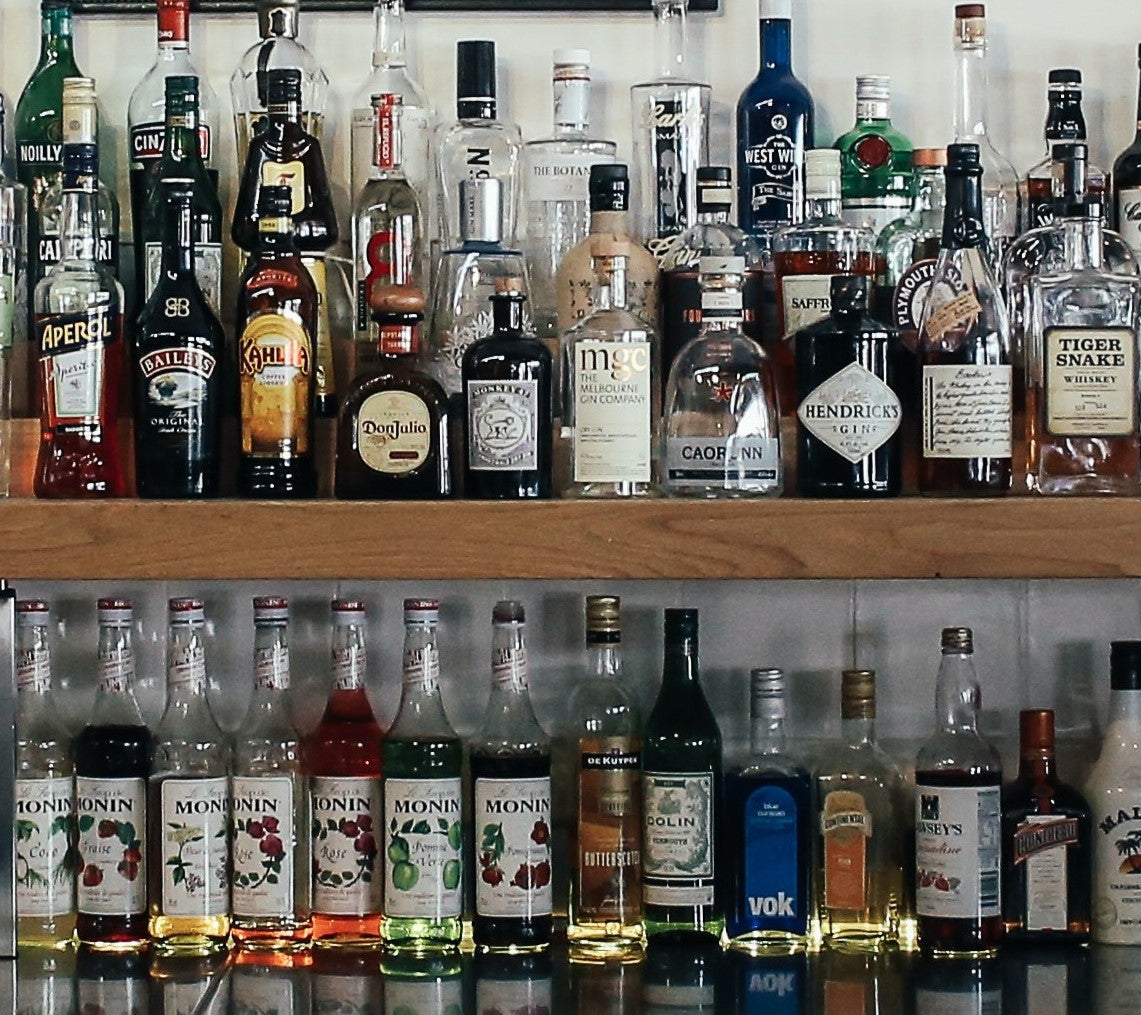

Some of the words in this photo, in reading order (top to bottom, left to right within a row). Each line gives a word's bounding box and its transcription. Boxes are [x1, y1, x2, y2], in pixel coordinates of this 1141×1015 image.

[20, 145, 62, 163] NOILLY
[745, 149, 775, 164] WEST
[553, 166, 591, 176] BOTAN
[791, 297, 831, 310] SAFFR
[42, 317, 112, 351] APEROL
[1058, 338, 1122, 352] TIGER
[144, 350, 212, 372] BAILEYS
[1056, 353, 1125, 367] SNAKE
[1063, 375, 1118, 384] WHISKEY
[805, 404, 899, 419] HENDRICK'S
[839, 424, 870, 435] GIN
[394, 798, 460, 813] MONIN
[486, 799, 550, 814] MONIN
[646, 816, 695, 827] DOLIN
[748, 892, 796, 917] vok
